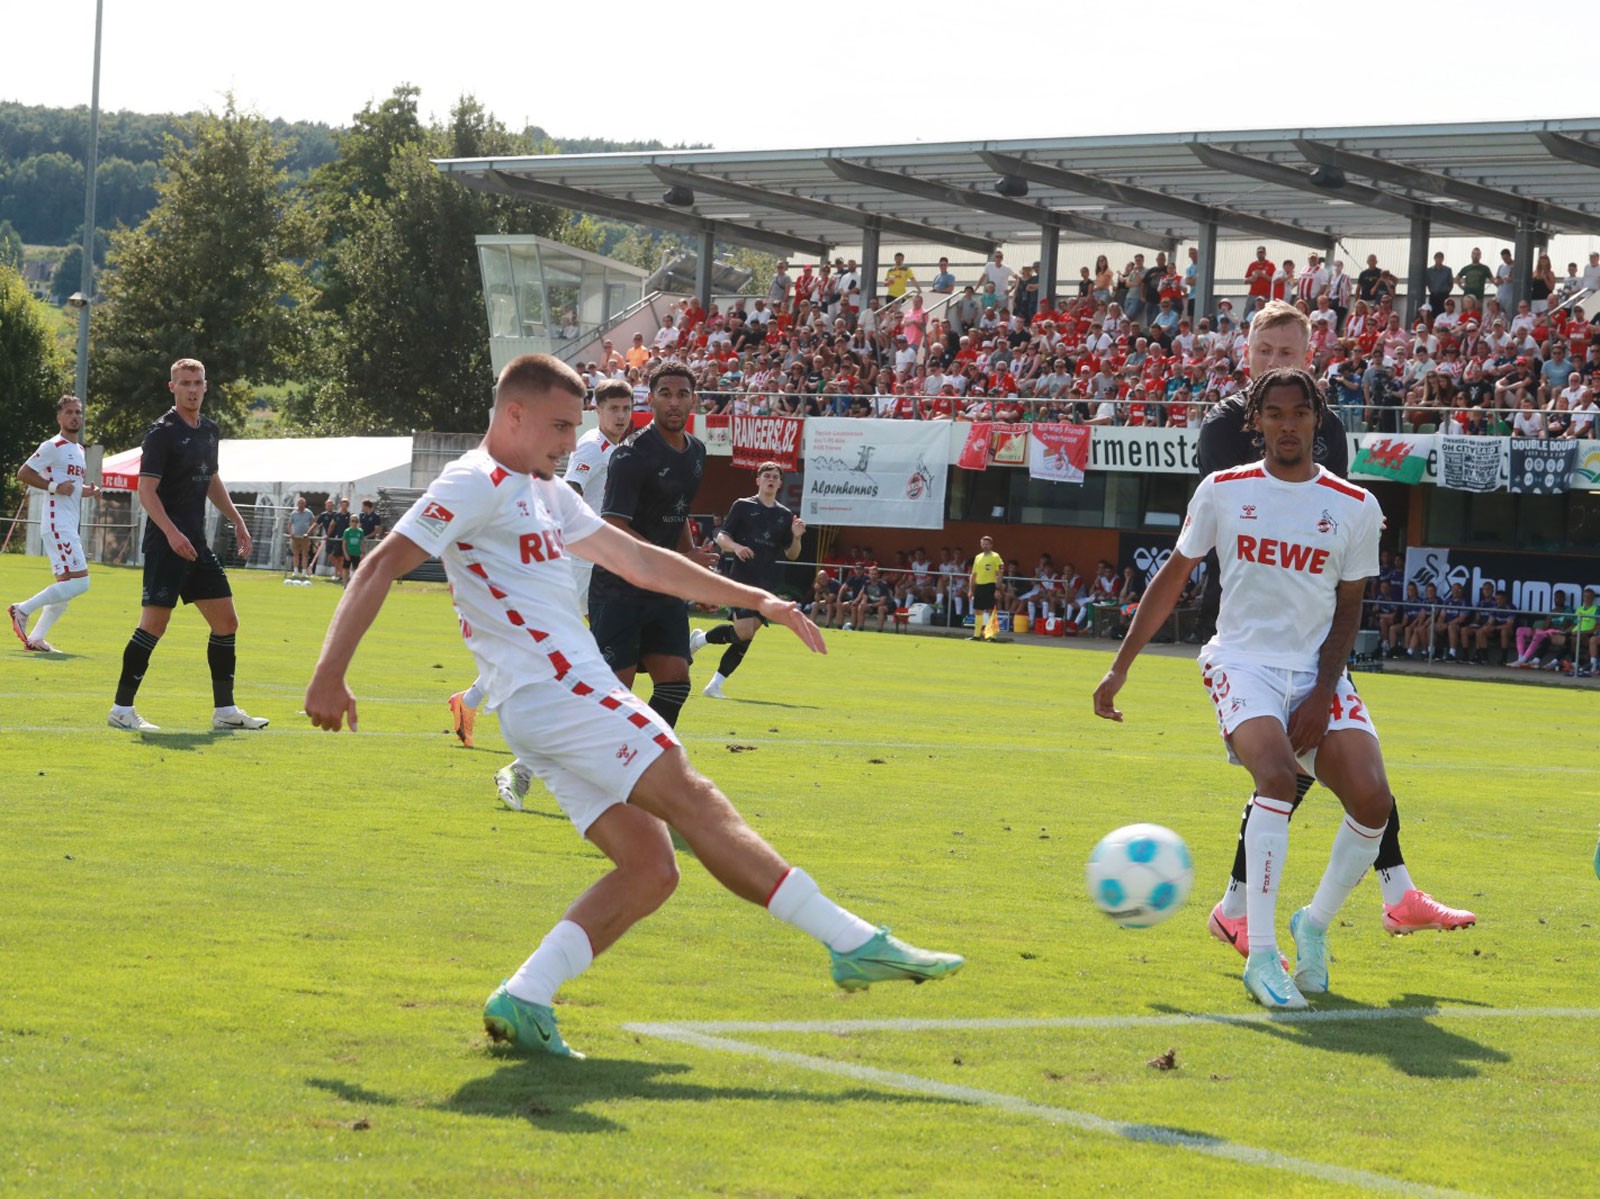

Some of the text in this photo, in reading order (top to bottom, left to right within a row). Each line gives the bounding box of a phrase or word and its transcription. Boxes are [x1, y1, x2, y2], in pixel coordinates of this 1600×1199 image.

[782, 420, 798, 452] 82
[1512, 440, 1548, 450] DOUBLE
[811, 480, 879, 497] Alpenhennes
[1237, 534, 1330, 575] REWE
[1329, 693, 1367, 723] 42
